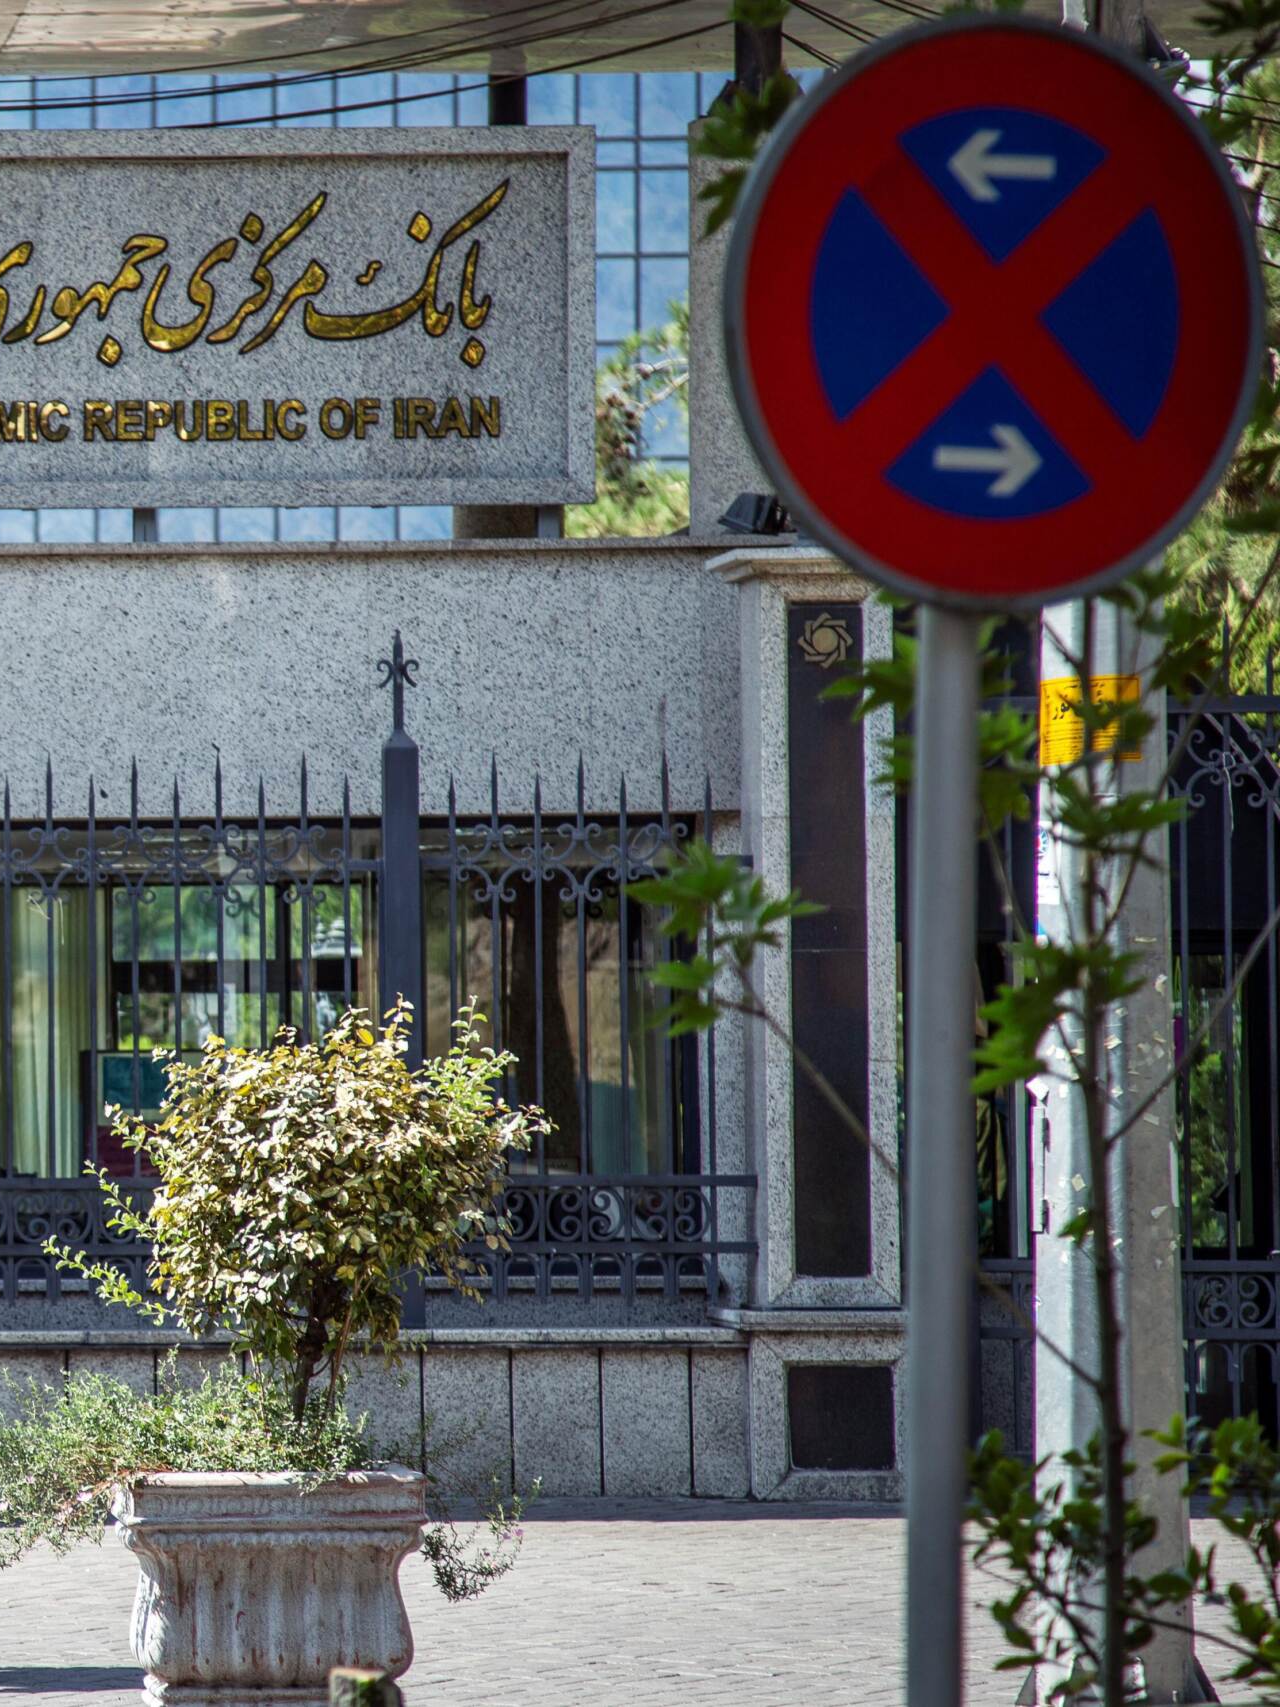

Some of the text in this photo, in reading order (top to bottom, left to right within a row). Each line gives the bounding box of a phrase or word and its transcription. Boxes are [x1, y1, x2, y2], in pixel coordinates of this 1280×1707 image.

[141, 191, 328, 354] مرکزی
[304, 177, 510, 369] بانک
[82, 399, 307, 443] REPUBLIC
[320, 397, 381, 440] OF
[392, 395, 501, 442] IRAN
